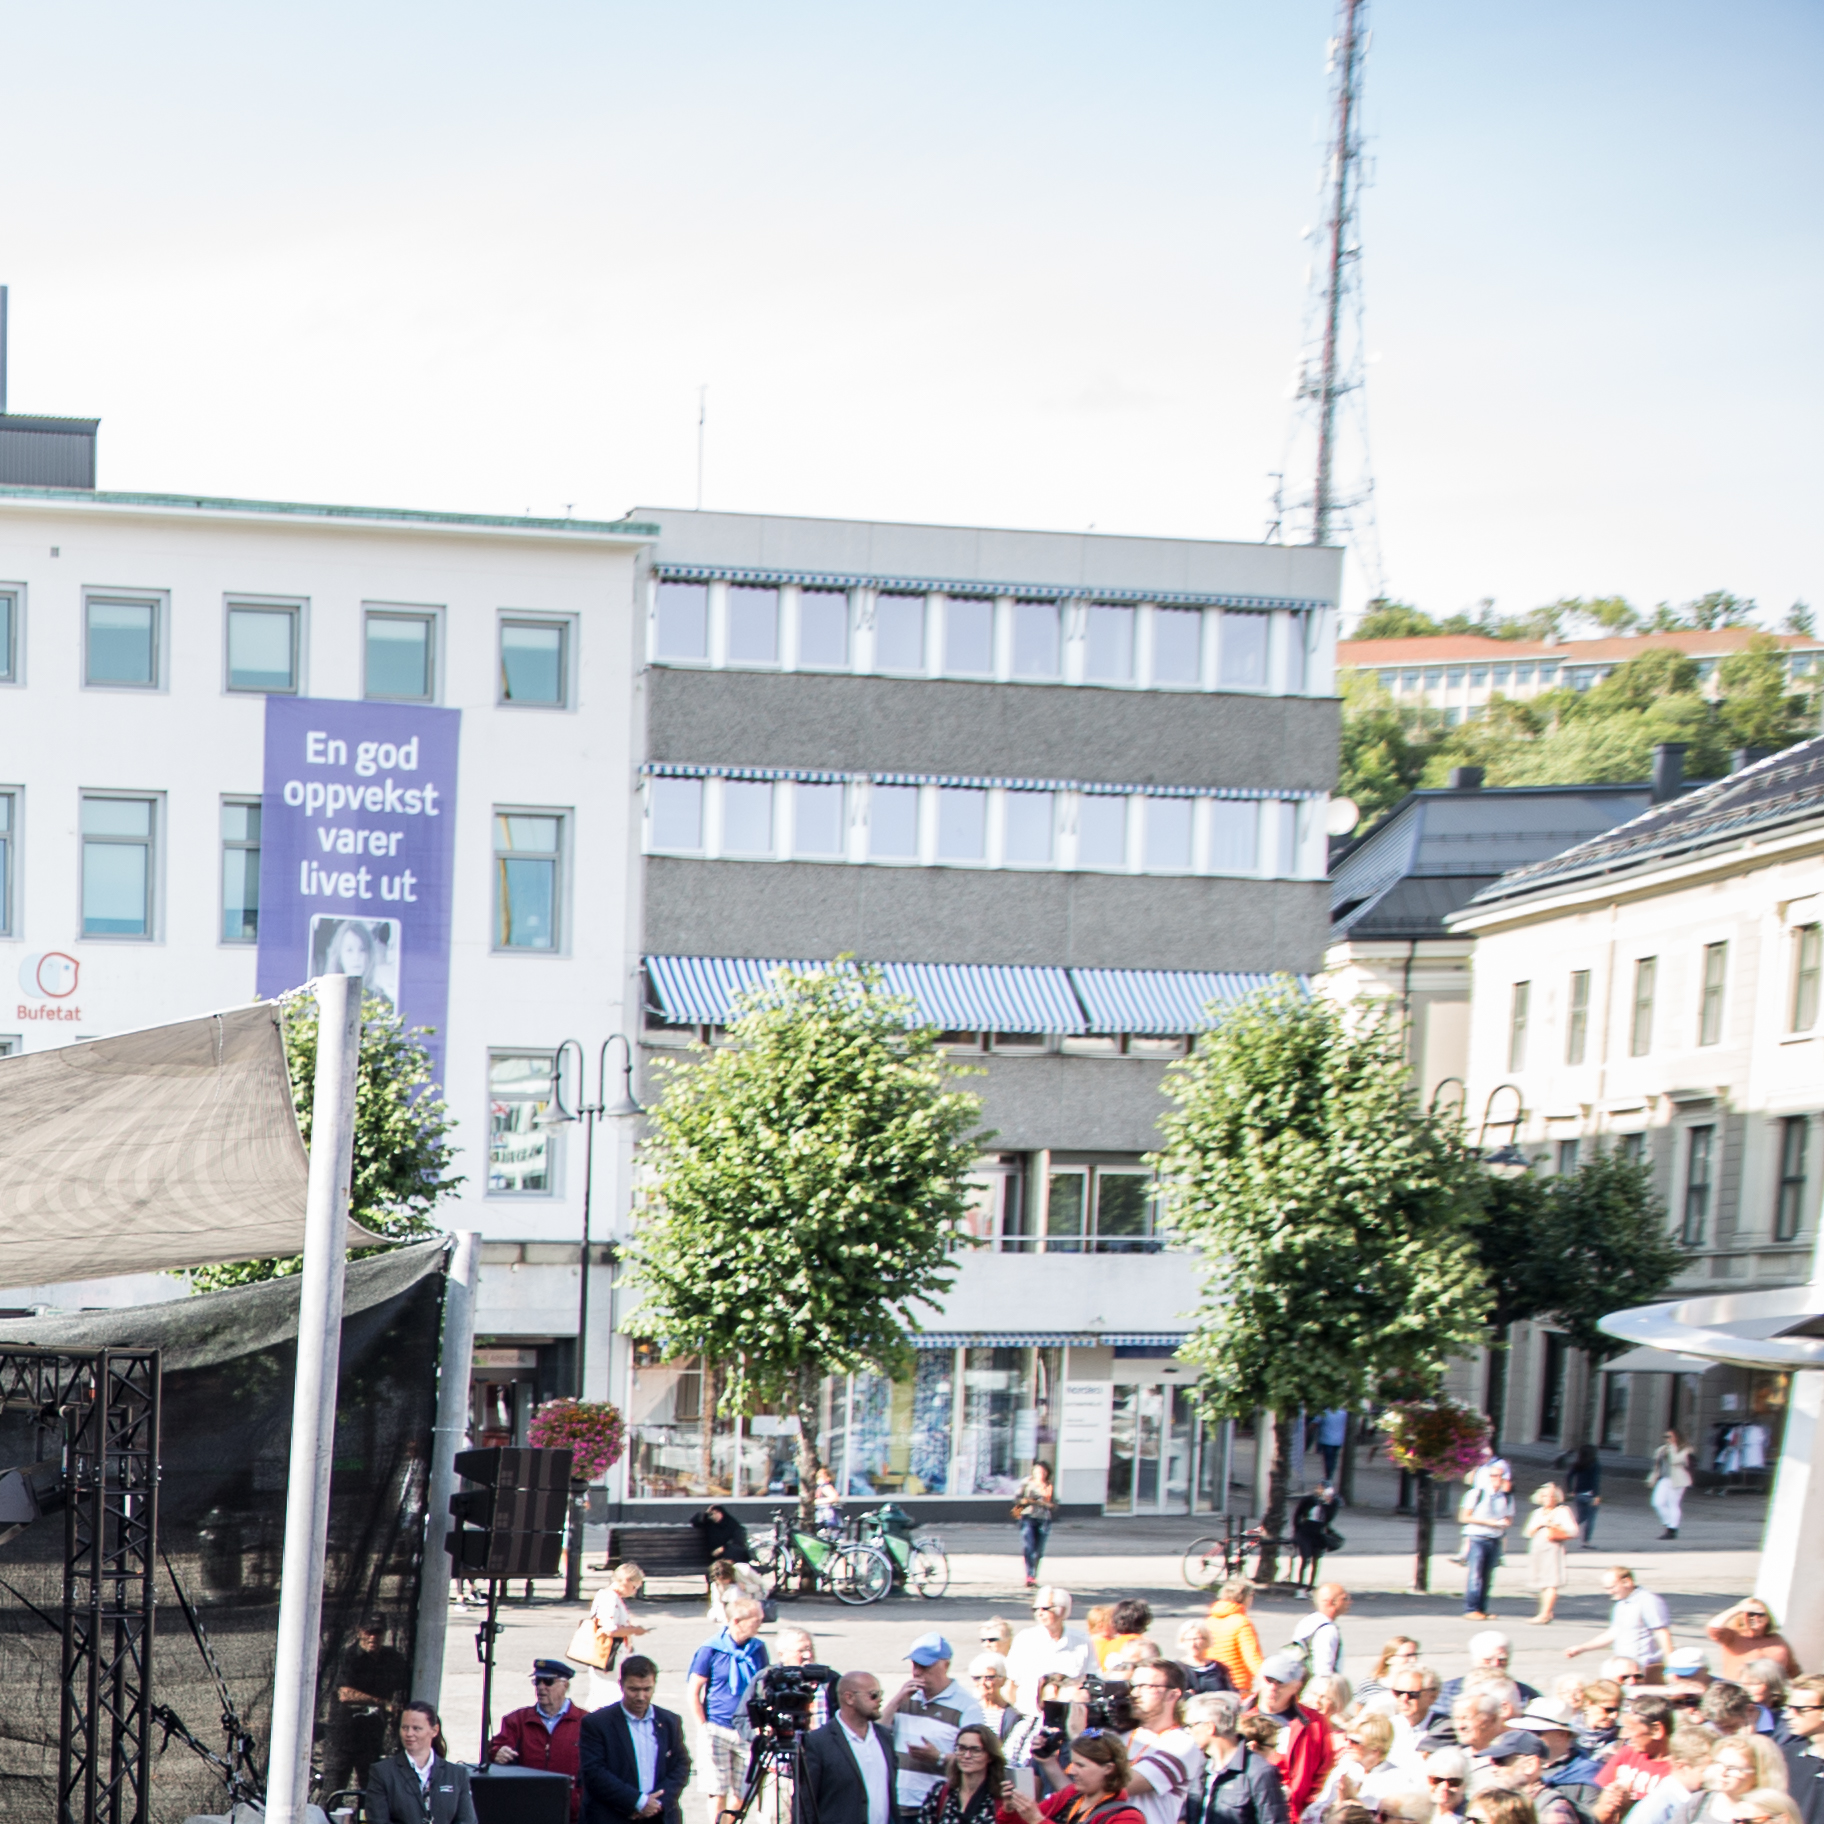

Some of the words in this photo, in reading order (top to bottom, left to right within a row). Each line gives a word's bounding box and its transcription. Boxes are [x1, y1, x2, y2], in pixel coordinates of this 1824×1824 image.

[306, 730, 347, 765] En
[355, 735, 419, 777] god
[283, 777, 440, 818] oppvekst
[317, 826, 403, 857] varer
[299, 860, 372, 899] livet
[380, 869, 417, 902] ut
[17, 1004, 81, 1021] Bufetat
